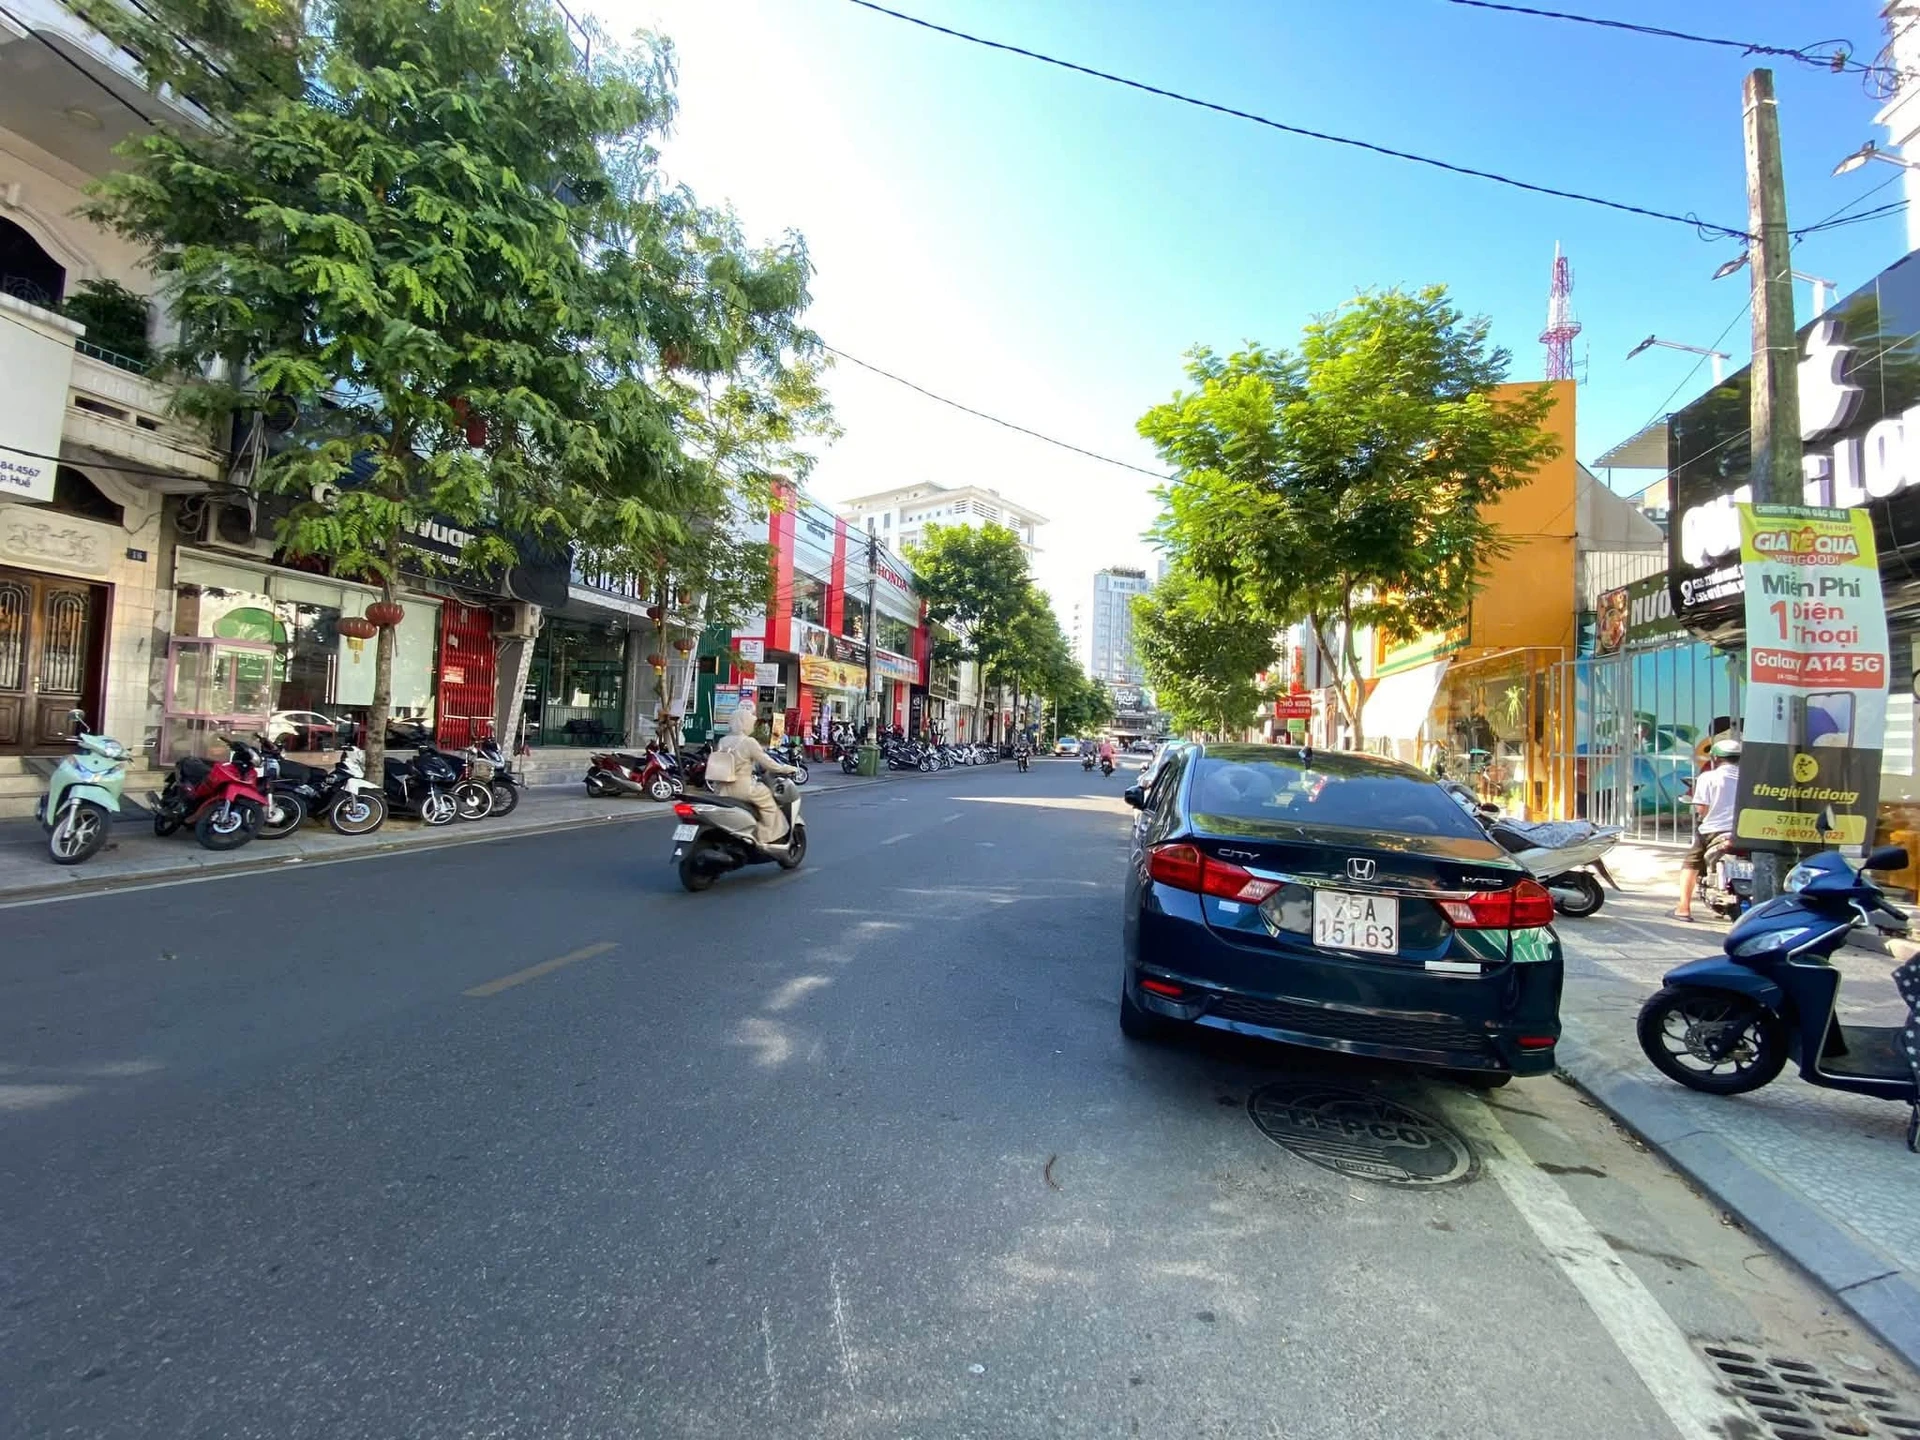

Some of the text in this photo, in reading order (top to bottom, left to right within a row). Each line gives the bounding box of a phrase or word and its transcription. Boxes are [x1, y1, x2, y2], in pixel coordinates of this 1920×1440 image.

[1754, 531, 1789, 552] GIÁ
[1814, 534, 1859, 556] QUÁ
[876, 563, 908, 593] HONDA
[1819, 577, 1861, 598] Phí
[1630, 576, 1676, 627] NƯỚ
[1770, 600, 1788, 640] 1
[1793, 625, 1859, 648] Thoại
[1755, 651, 1880, 673] Galaxy A14 5G
[1218, 847, 1261, 860] CITY
[1334, 894, 1377, 922] 75A
[1319, 919, 1394, 949] 151.63
